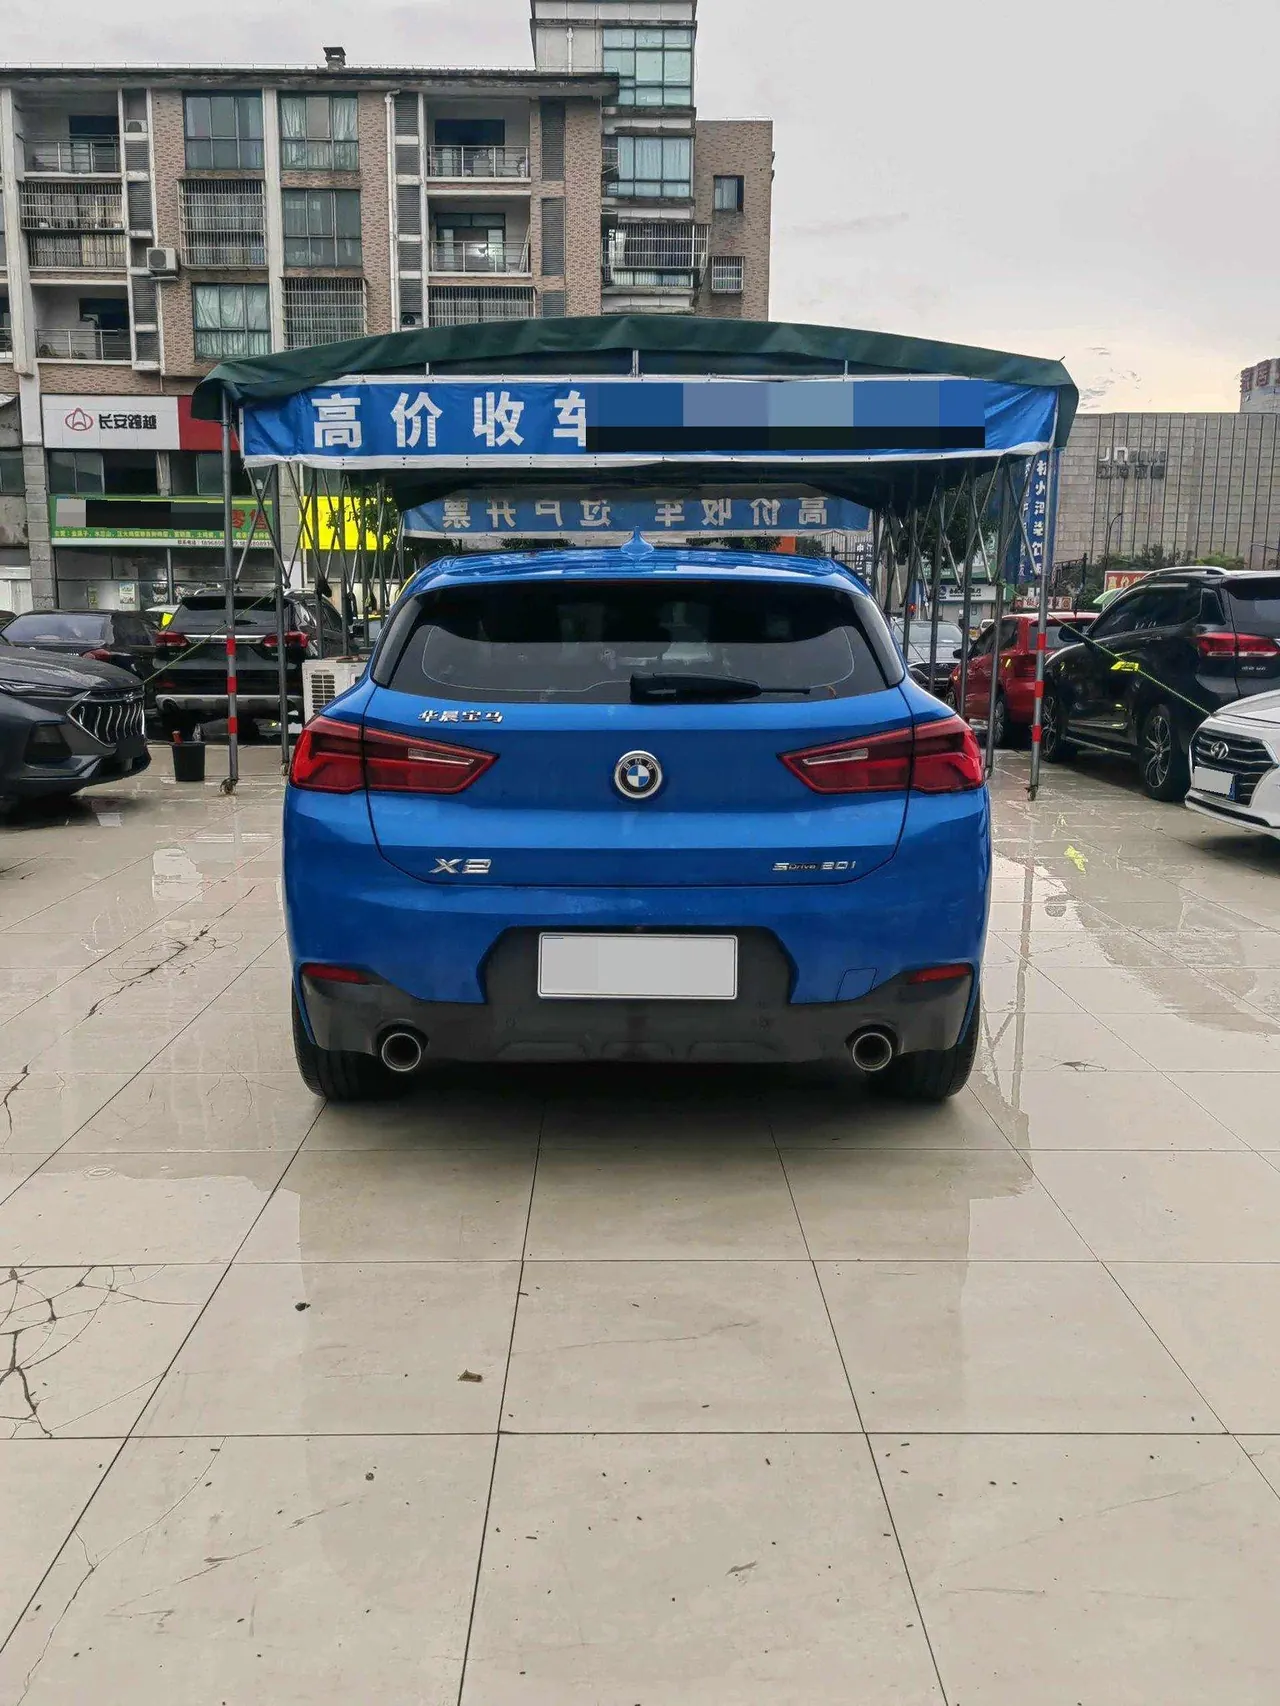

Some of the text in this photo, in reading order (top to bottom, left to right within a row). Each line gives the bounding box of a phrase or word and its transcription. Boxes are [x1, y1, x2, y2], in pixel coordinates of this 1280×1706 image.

[99, 413, 157, 430] 长安跨越
[418, 710, 504, 724] 华晨宝马
[429, 859, 492, 874] X2
